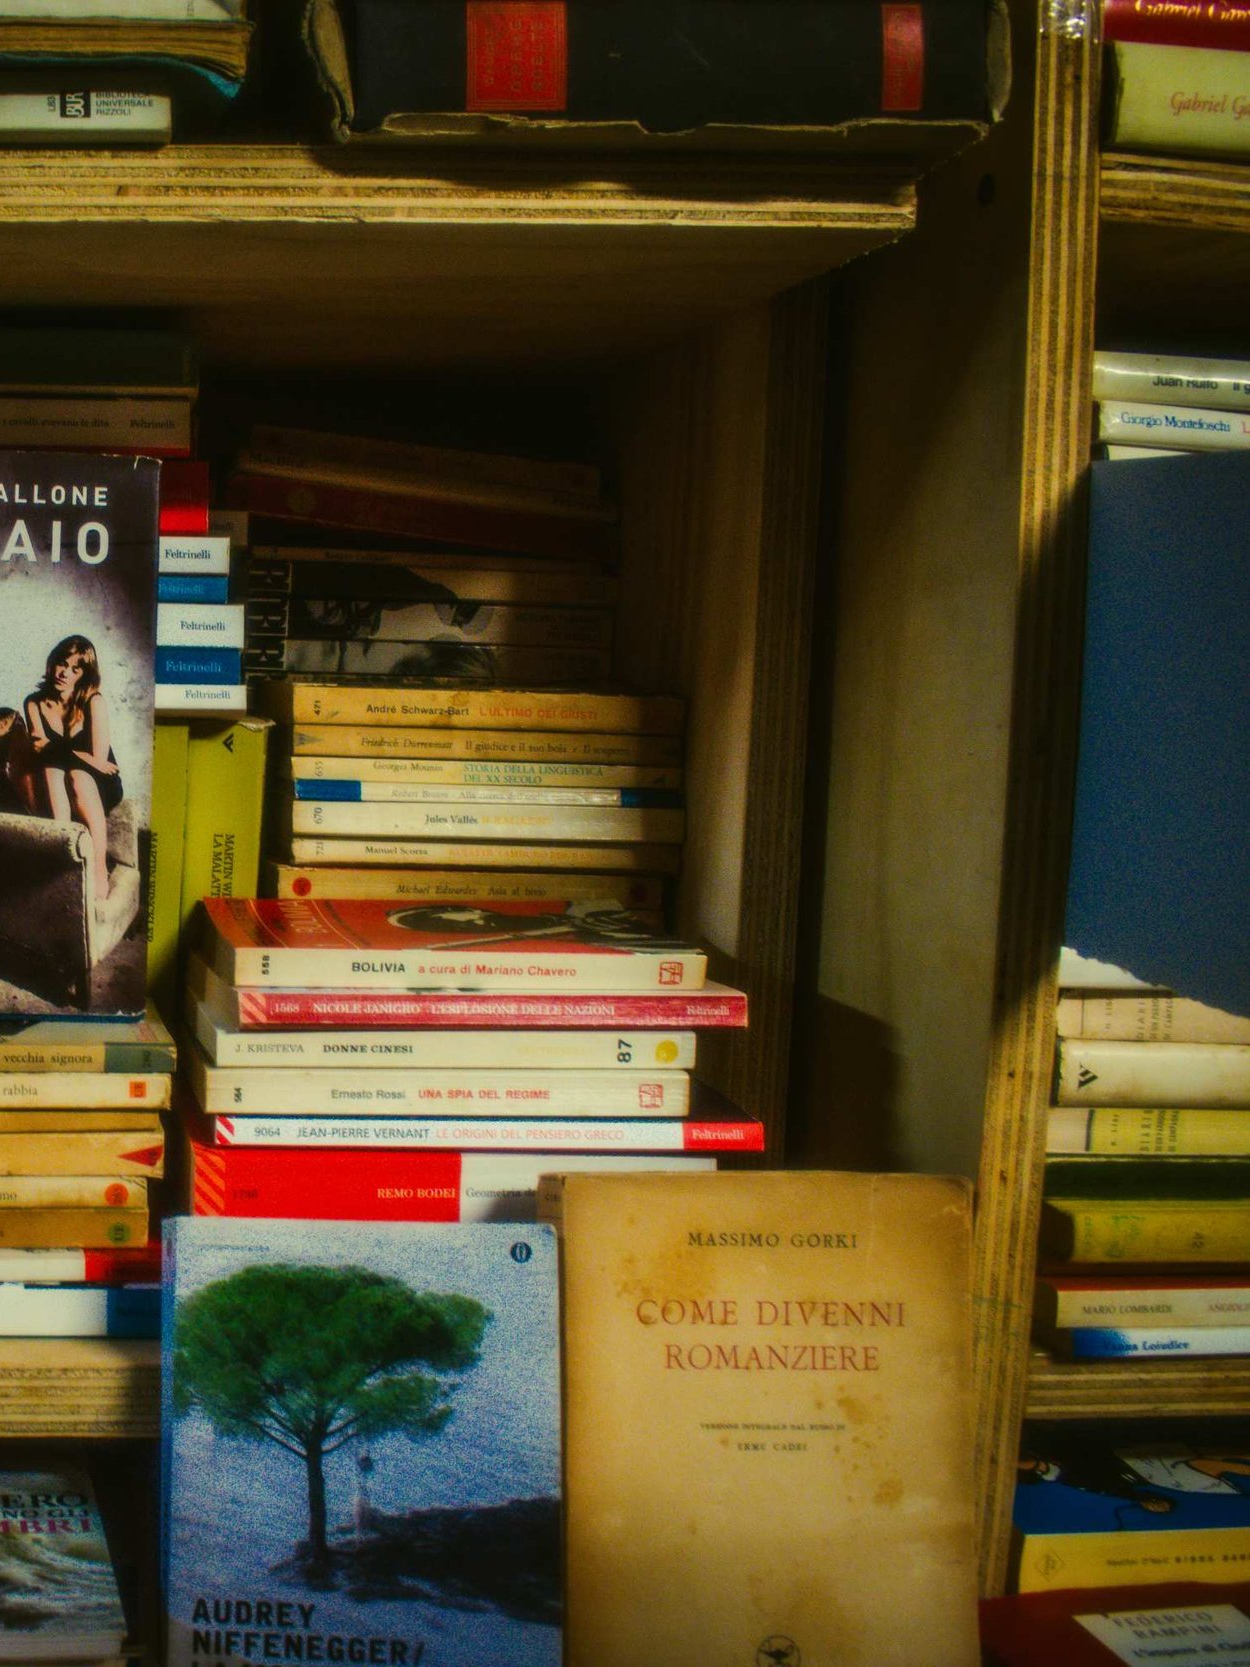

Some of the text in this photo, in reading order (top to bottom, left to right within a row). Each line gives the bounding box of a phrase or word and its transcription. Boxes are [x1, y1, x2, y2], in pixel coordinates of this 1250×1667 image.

[96, 100, 153, 108] UNIVERSALE
[1170, 91, 1227, 117] Gabriel
[1152, 375, 1183, 388] Juan
[1121, 412, 1162, 428] Giorgio
[164, 548, 212, 561] Feltrinelli
[180, 620, 226, 633] Feltrinelli
[165, 660, 222, 674] Feltrinelli
[185, 690, 231, 701] Feltrinelli
[366, 704, 470, 717] André Schwarz-Bart
[538, 766, 603, 777] LINGUISTICA
[425, 814, 449, 825] Jules
[223, 833, 235, 880] MARTIN
[351, 962, 577, 977] BOLIVIA cura di Mariano Chavero
[312, 1003, 615, 1016] NICOLE DELLE NAZIONI
[686, 1005, 730, 1016] Feltrinelli
[247, 1043, 414, 1054] KRISTEVA DONNE CINESI
[617, 1039, 632, 1063] 87
[2, 1052, 45, 1064] vecchia
[50, 1053, 93, 1067] signora
[2, 1084, 39, 1096] rabbia
[331, 1088, 550, 1100] Ernesto Rossi UNA SPIA DEL REGIME
[253, 1127, 625, 1141] 9064 JEAN-PIERRE VERNANT LE ORIGINI DEL PENSIERO GRECO
[691, 1128, 744, 1140] Feltrinelli
[376, 1188, 457, 1199] REMO BODEI
[465, 1187, 523, 1202] Geometria
[687, 1231, 859, 1249] MASSIMO GORKI
[636, 1299, 906, 1328] COME DIVENNI
[1081, 1304, 1174, 1315] MARIO LOMBARDI
[664, 1344, 881, 1372] ROMANZIERE
[191, 1599, 317, 1631] AUDREY
[1112, 1612, 1213, 1627] FEDERICO
[1132, 1625, 1223, 1640] RAMPINI
